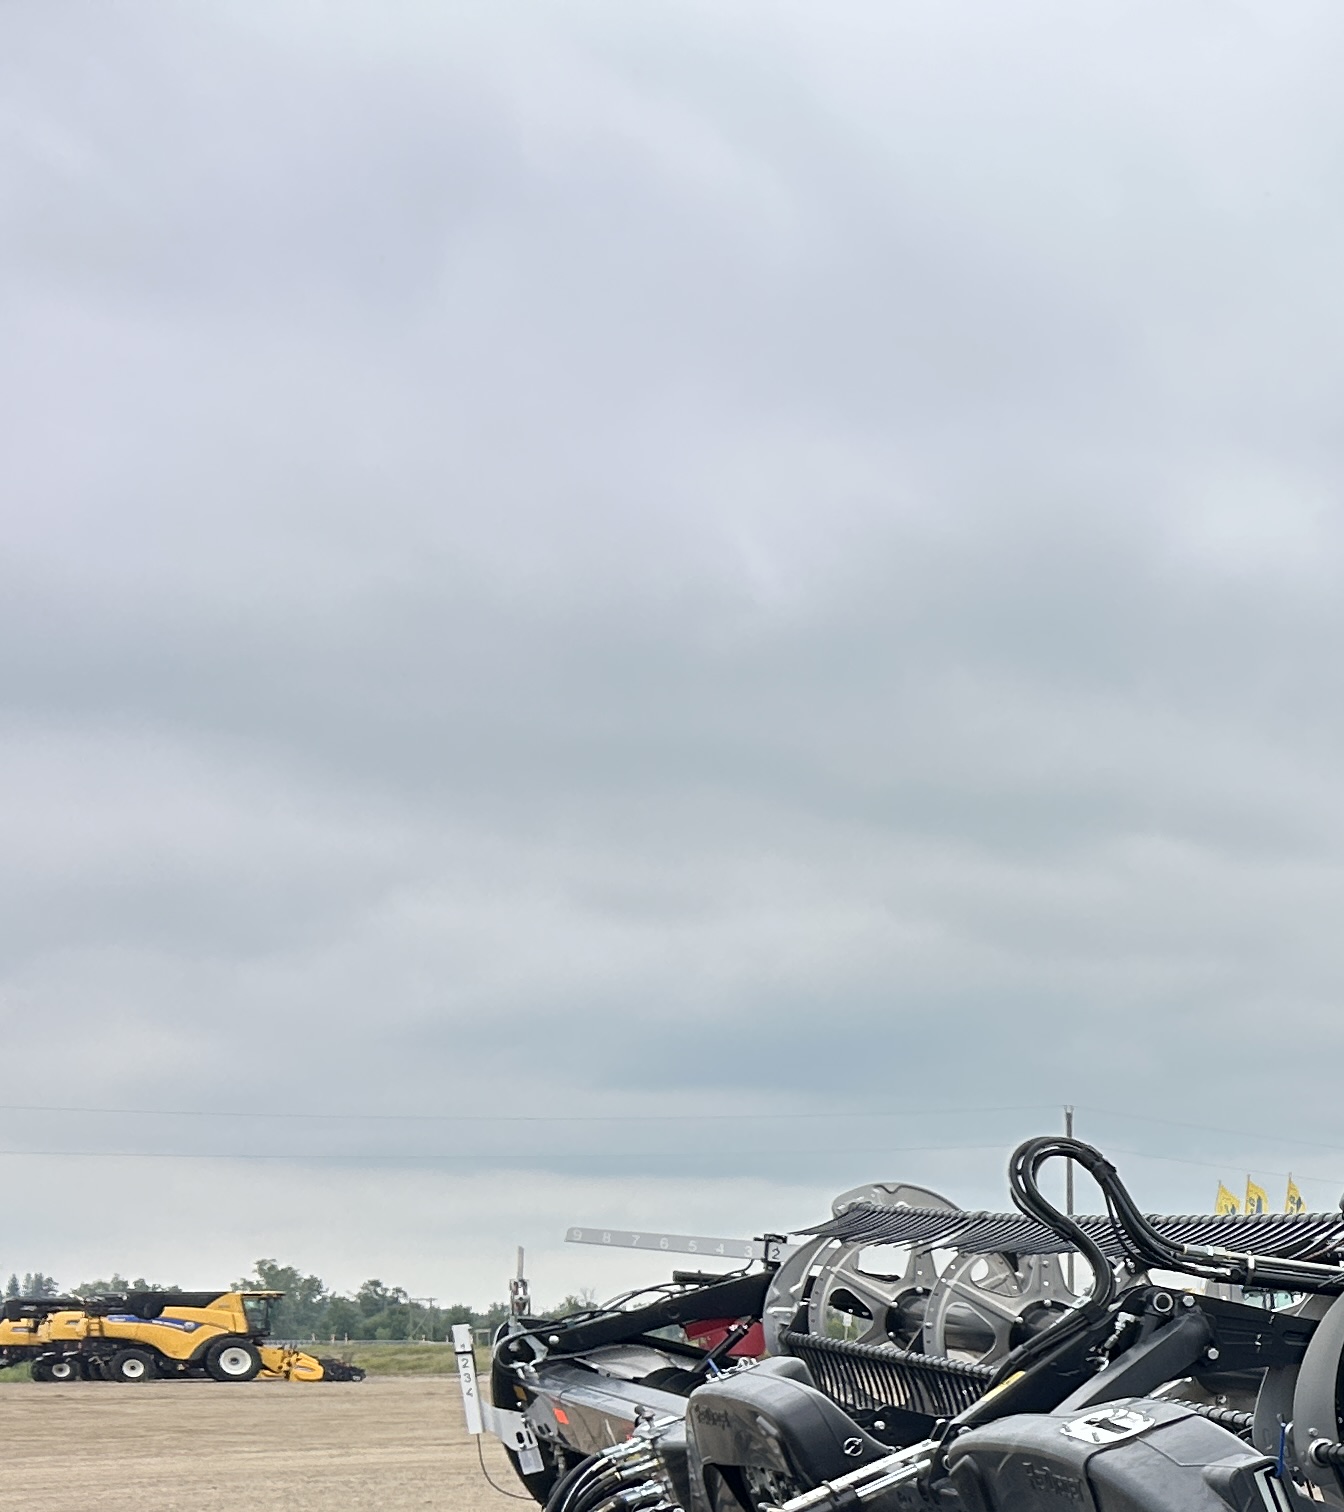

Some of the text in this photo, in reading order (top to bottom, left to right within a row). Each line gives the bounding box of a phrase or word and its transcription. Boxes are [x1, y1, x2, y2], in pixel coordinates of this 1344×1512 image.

[572, 1230, 583, 1241] 9
[602, 1232, 611, 1244] 8
[631, 1235, 641, 1246] 7
[660, 1238, 669, 1249] 6
[688, 1240, 697, 1252] 5
[461, 1358, 469, 1369] 2
[464, 1373, 472, 1383] 3
